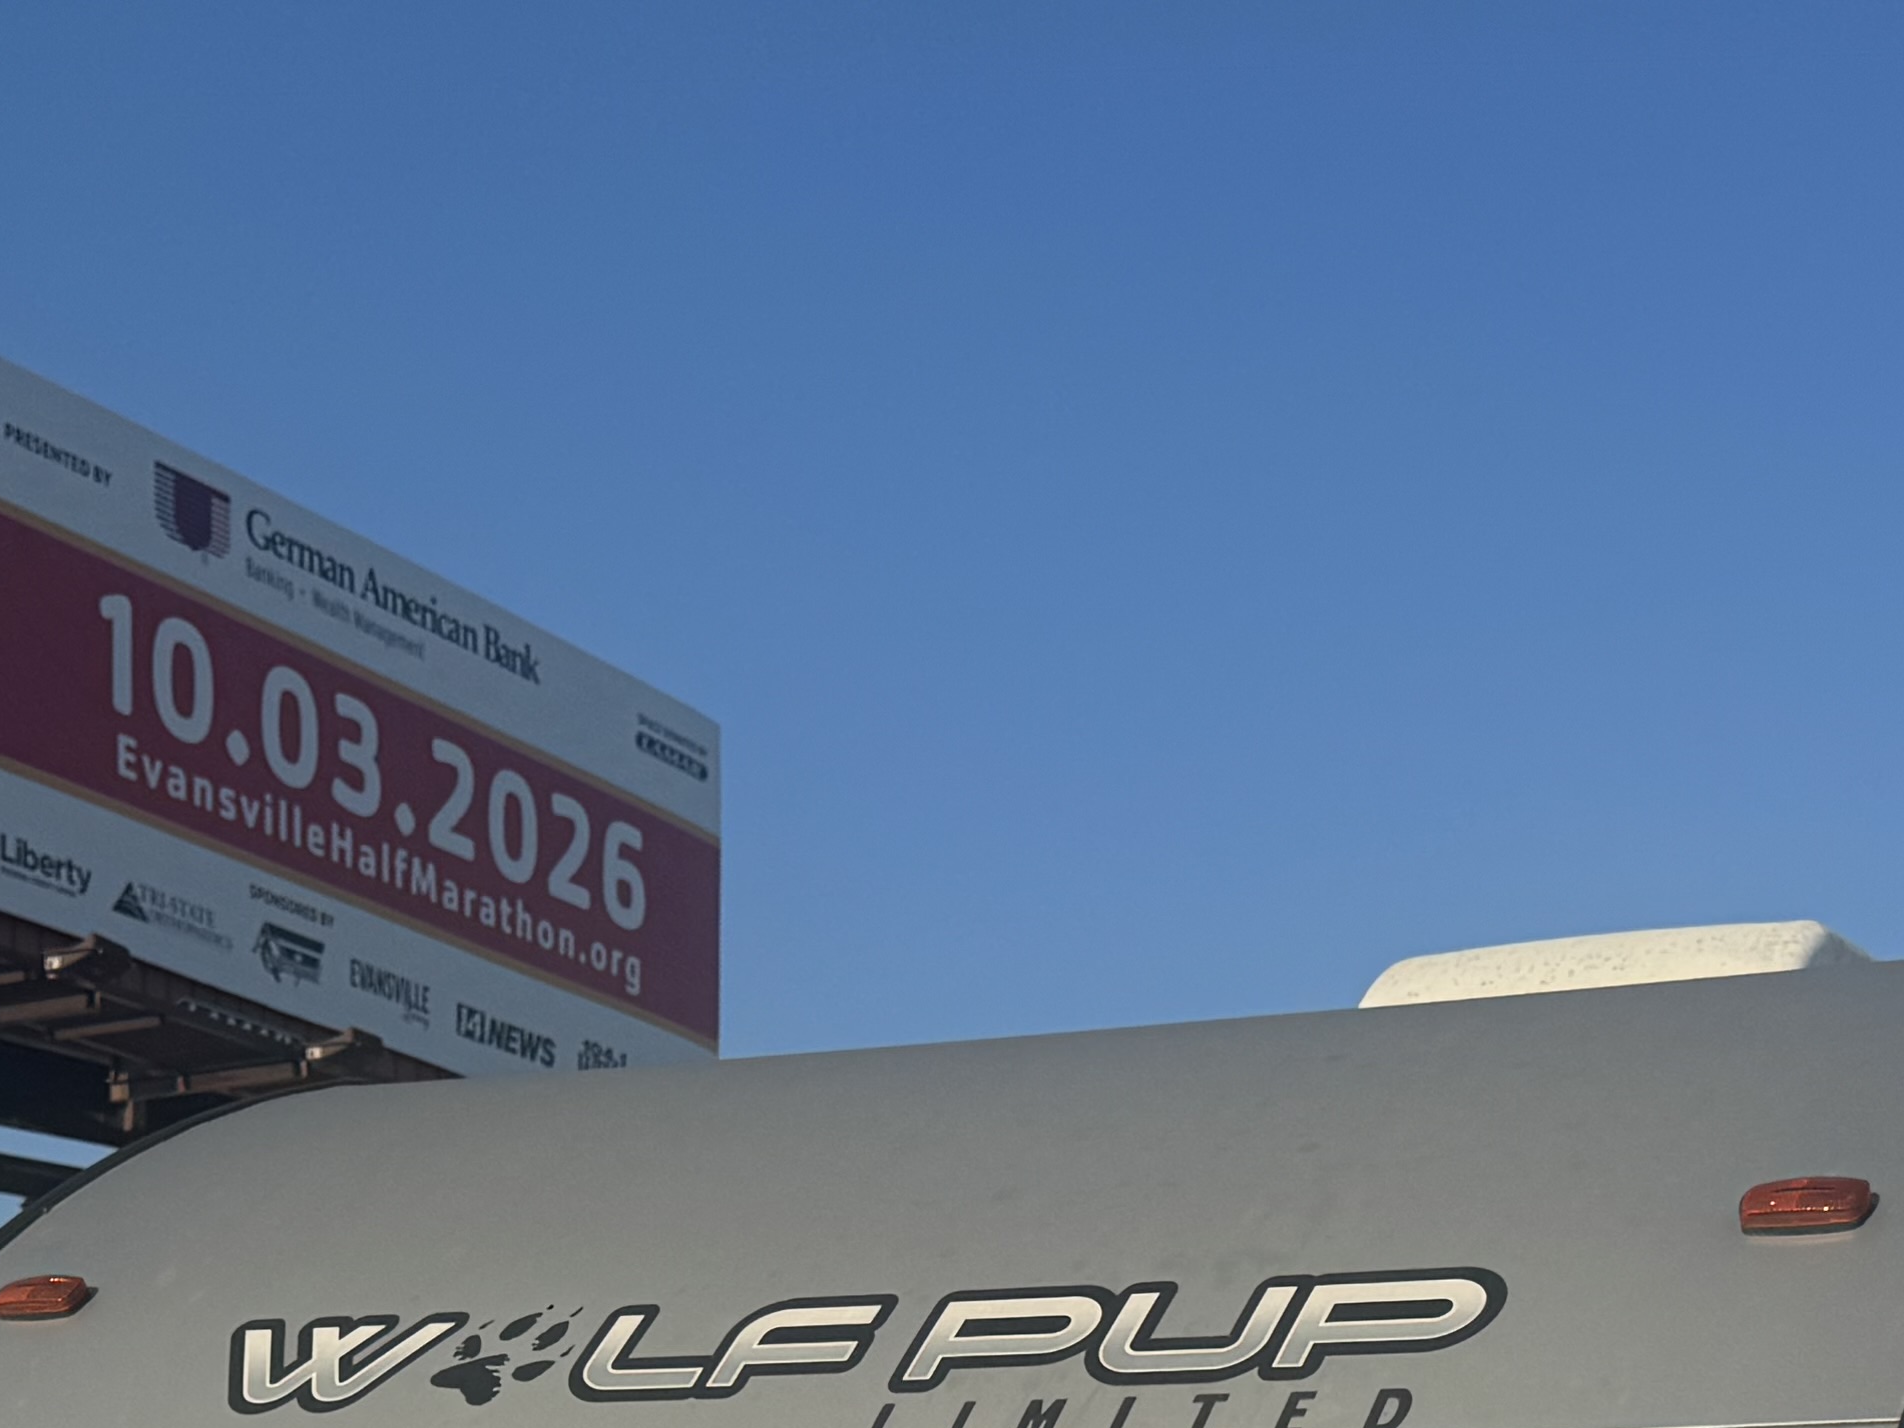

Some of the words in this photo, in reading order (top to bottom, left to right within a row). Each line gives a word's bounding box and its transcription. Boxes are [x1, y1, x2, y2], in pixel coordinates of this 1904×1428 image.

[4, 422, 91, 479] PRESENTED
[92, 469, 113, 489] BY
[246, 509, 356, 595] German
[360, 567, 479, 655] American
[483, 623, 541, 686] Bank
[99, 594, 646, 931] 10.03.2026
[0, 833, 92, 895] Liberty
[116, 733, 642, 994] EvansvilleHalfMarathon.org
[350, 958, 431, 1015] EVANSVILLE
[488, 1017, 557, 1068] NEWS
[228, 1294, 899, 1416] WLF
[886, 1266, 1508, 1395] PUP
